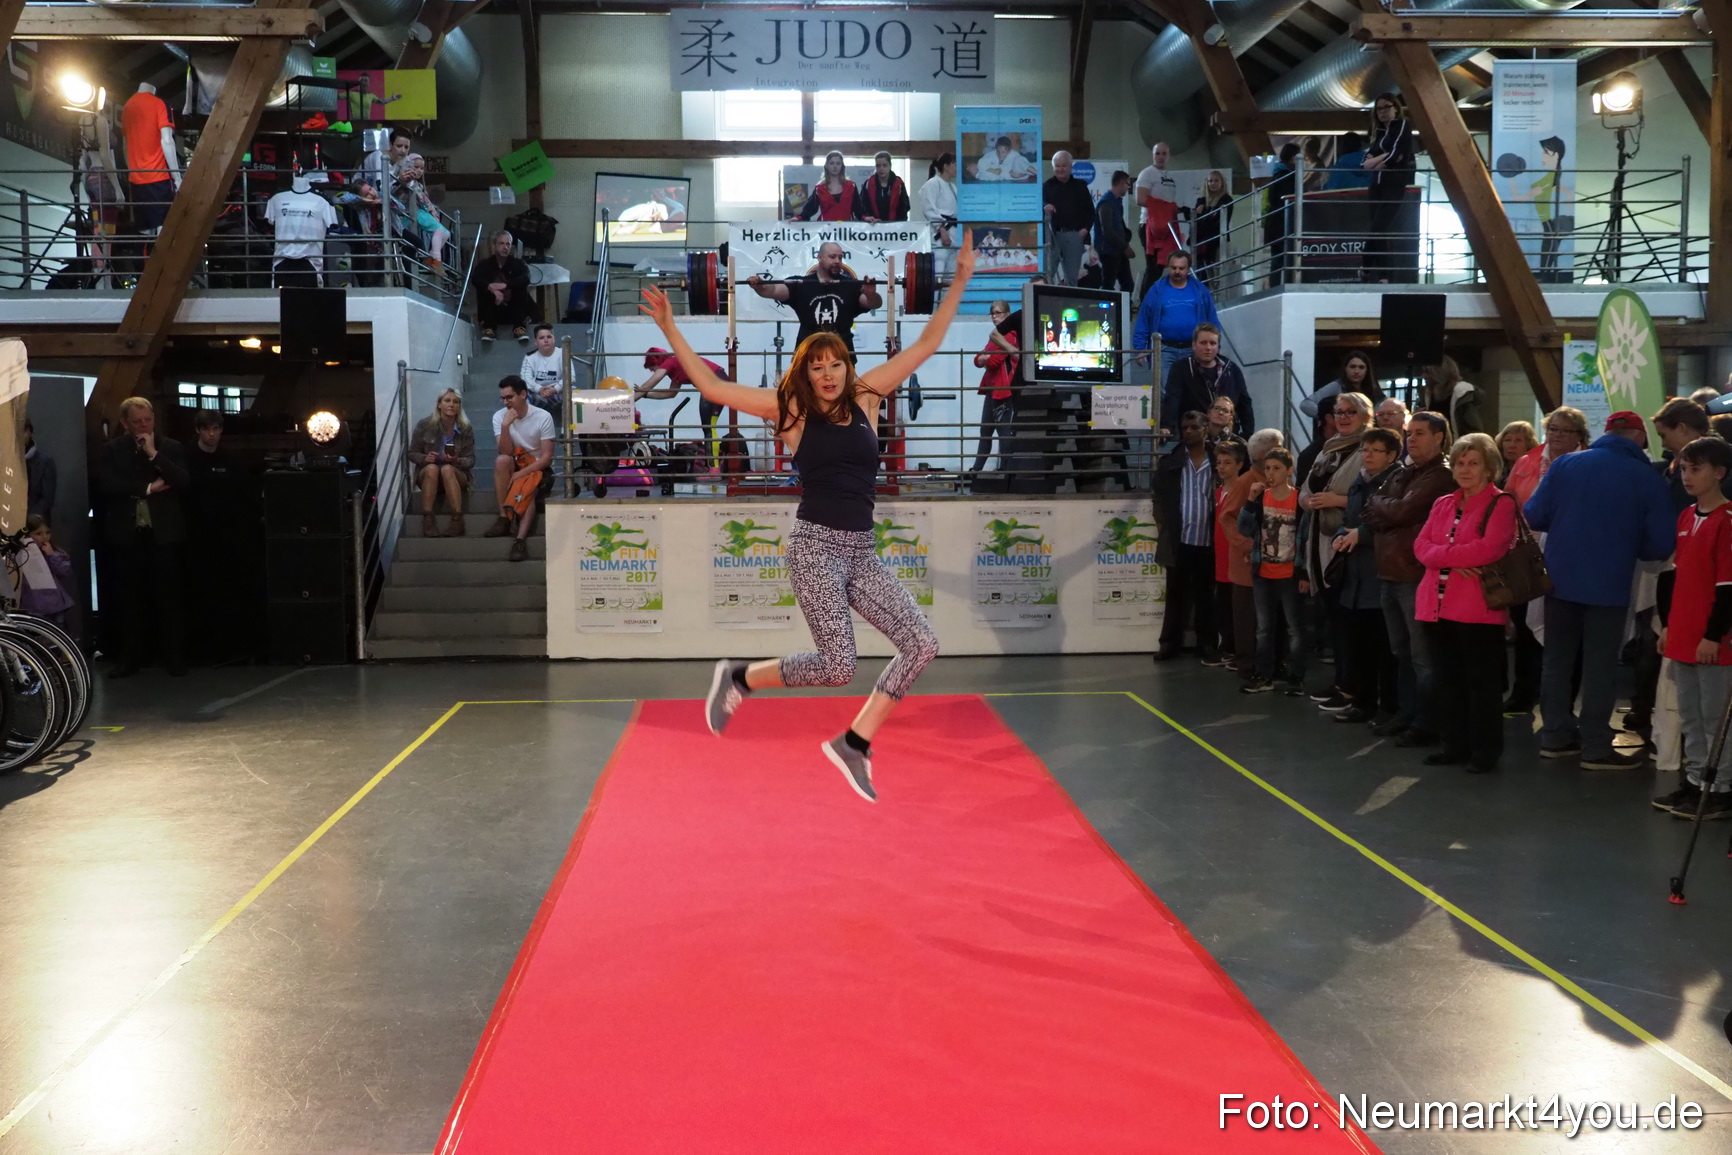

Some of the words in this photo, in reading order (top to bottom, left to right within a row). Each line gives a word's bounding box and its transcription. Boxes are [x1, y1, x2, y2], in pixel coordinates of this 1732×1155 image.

[680, 18, 738, 77] 柔
[755, 18, 912, 66] JUDO
[930, 21, 988, 79] 道
[798, 61, 813, 70] Der
[819, 61, 850, 70] sanfte
[855, 61, 871, 71] Weg
[755, 77, 818, 88] Integration
[861, 78, 911, 88] Inklusion
[742, 229, 811, 242] Herzlich
[819, 228, 919, 242] willkommen
[812, 247, 851, 260] bm
[1302, 242, 1338, 257] BODY
[620, 547, 640, 559] FIT
[644, 547, 657, 559] IN
[753, 544, 774, 556] FIT
[891, 544, 911, 555] FIT
[915, 544, 928, 555] IN
[1015, 543, 1036, 555] FIT
[1040, 543, 1053, 555] IN
[1135, 541, 1155, 553] FIT
[713, 556, 788, 568] NEUMARKT
[880, 555, 928, 567] MARKT
[977, 554, 1052, 567] NEUMARKT
[1097, 552, 1154, 565] NEUMAR
[580, 560, 657, 571] NEUMARKT
[1141, 564, 1163, 576] 201
[626, 571, 657, 583] 2017
[759, 567, 790, 579] 2017
[897, 567, 928, 579] 2017
[1021, 566, 1052, 578] 2017
